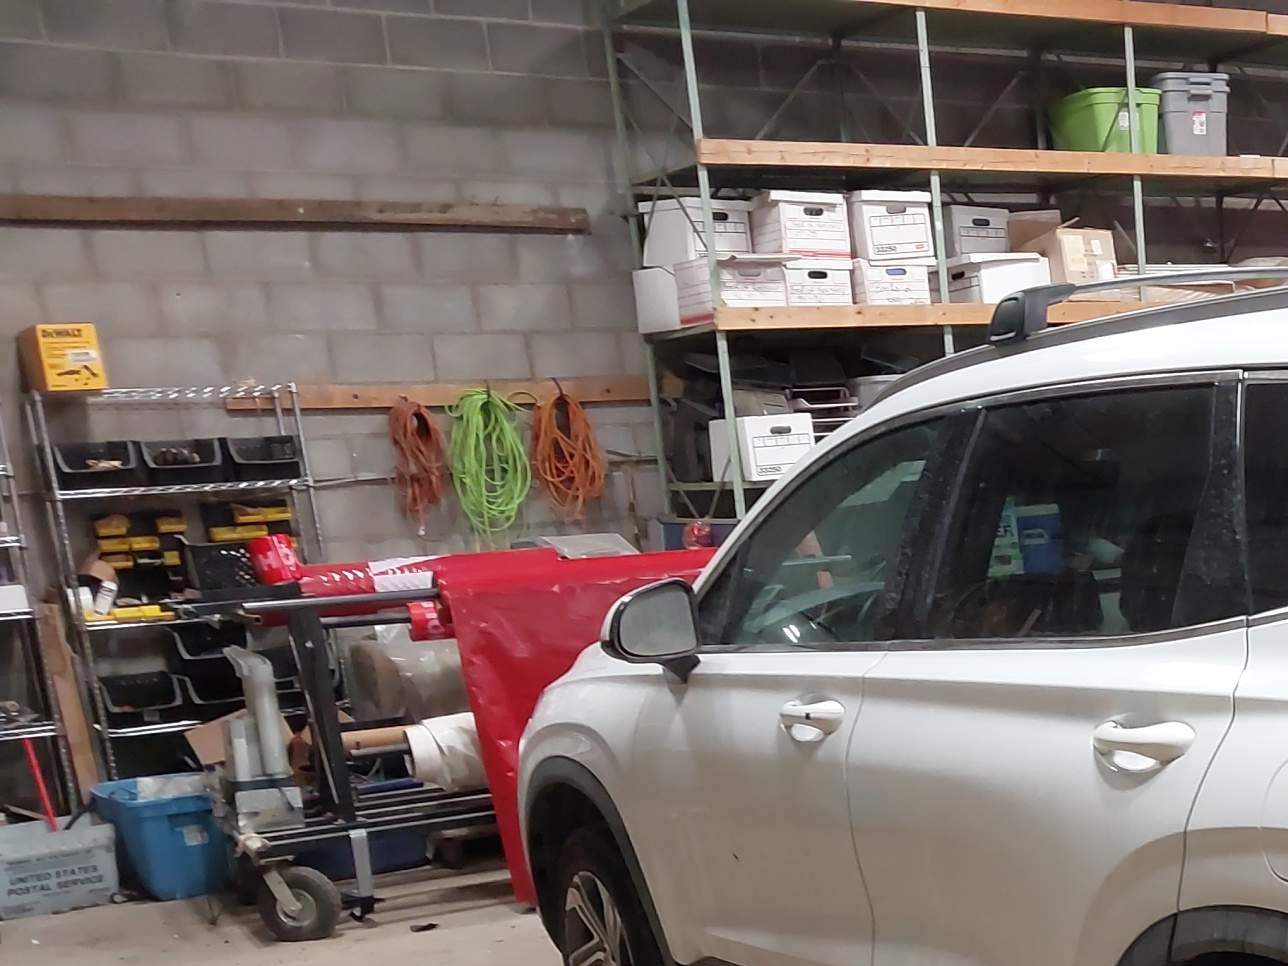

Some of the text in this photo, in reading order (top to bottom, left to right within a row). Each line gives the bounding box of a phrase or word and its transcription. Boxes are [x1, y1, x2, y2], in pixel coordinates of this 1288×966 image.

[8, 883, 52, 897] POSTAL
[56, 874, 104, 889] SERVICE
[9, 864, 98, 886] UNITED STATES
